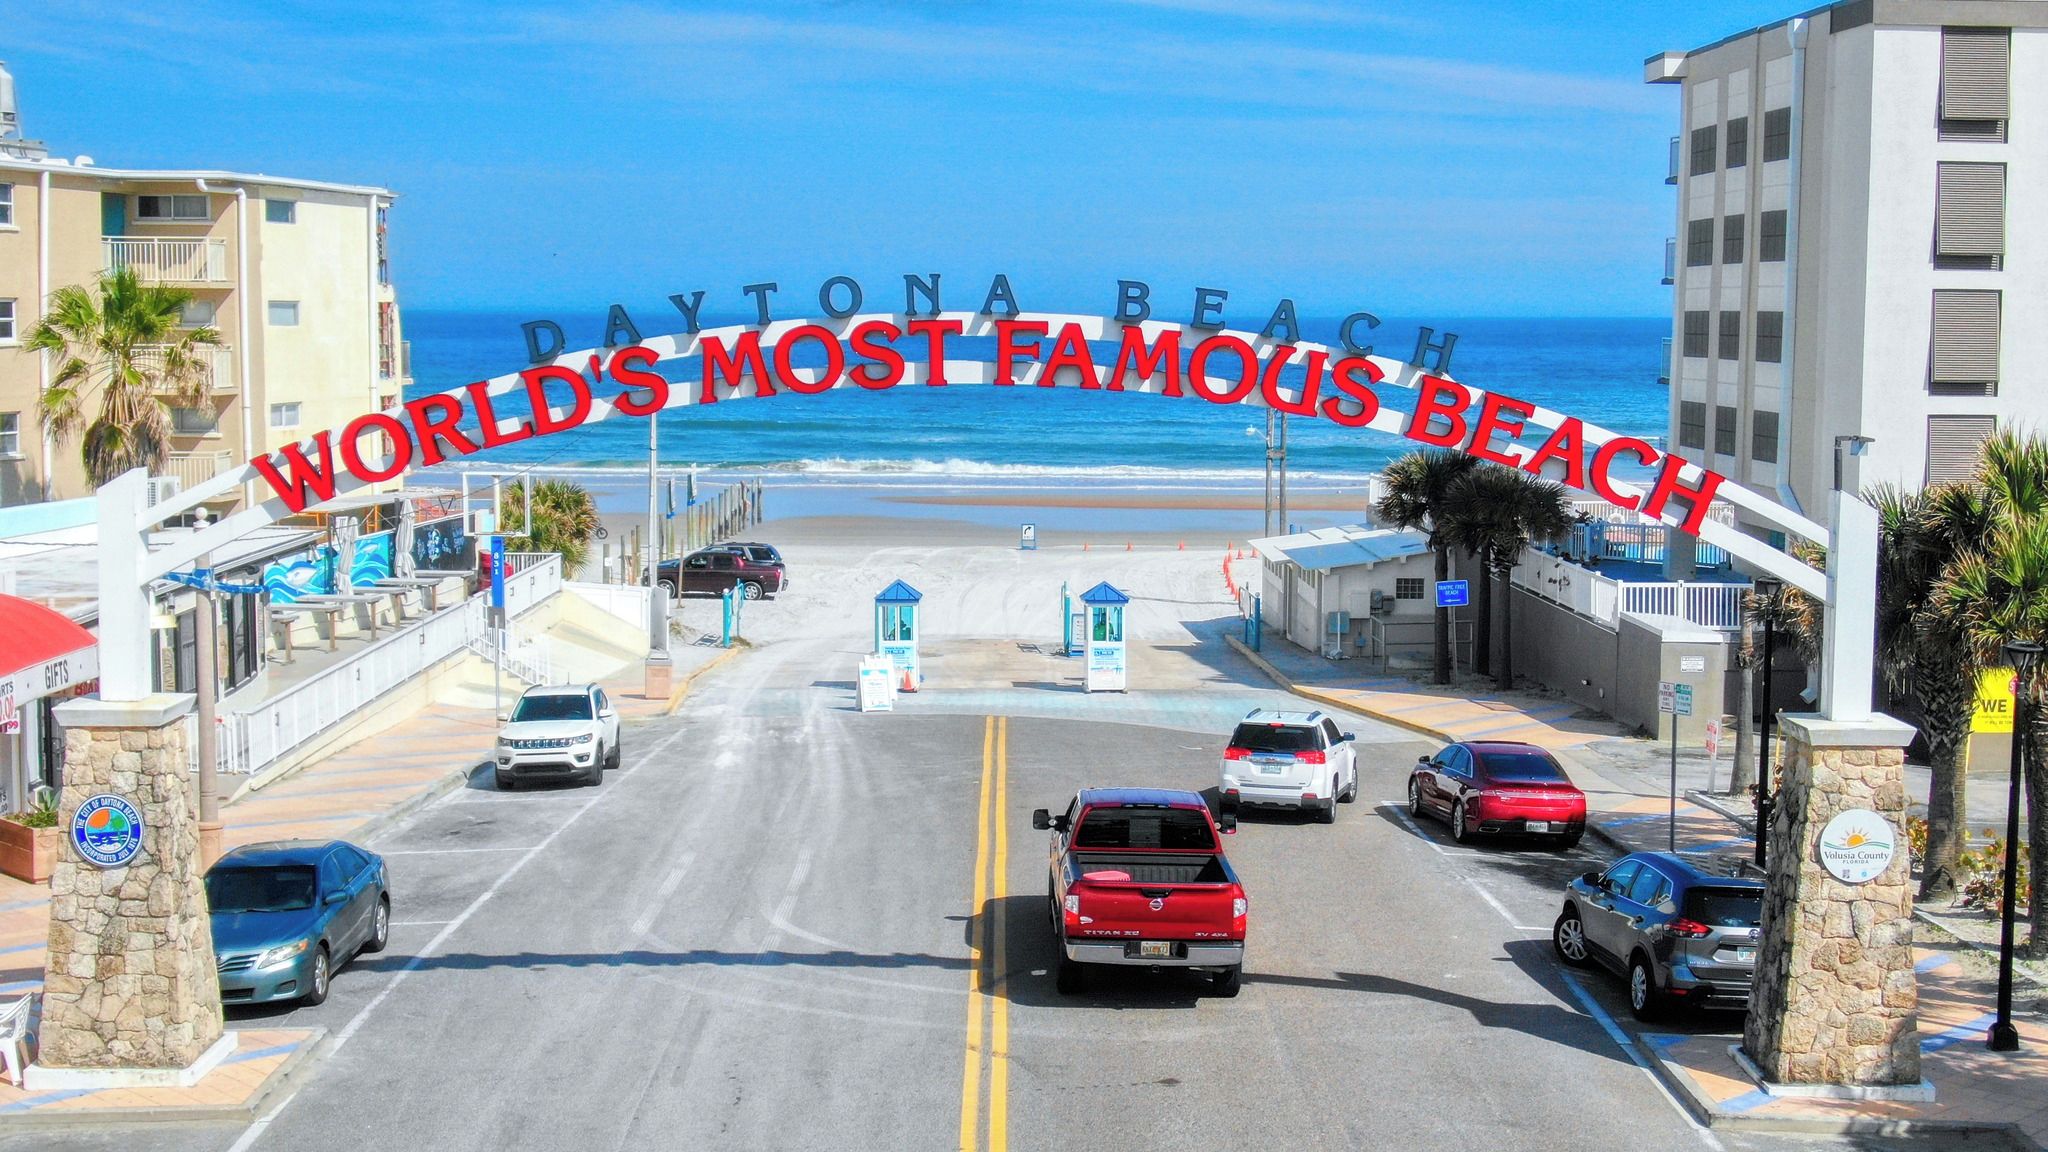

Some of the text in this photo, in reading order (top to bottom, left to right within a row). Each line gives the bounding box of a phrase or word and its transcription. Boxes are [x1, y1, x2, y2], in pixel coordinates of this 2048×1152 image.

[520, 273, 1460, 374] DAYTONA BEACH
[249, 319, 1726, 537] WORLD'S MOST FAMOUS BEACH
[45, 660, 69, 690] GIFTS
[76, 798, 138, 829] THE CITY OF DAYTONA BEACH
[80, 840, 117, 862] INCORPORATED
[1824, 851, 1889, 861] Volusia County
